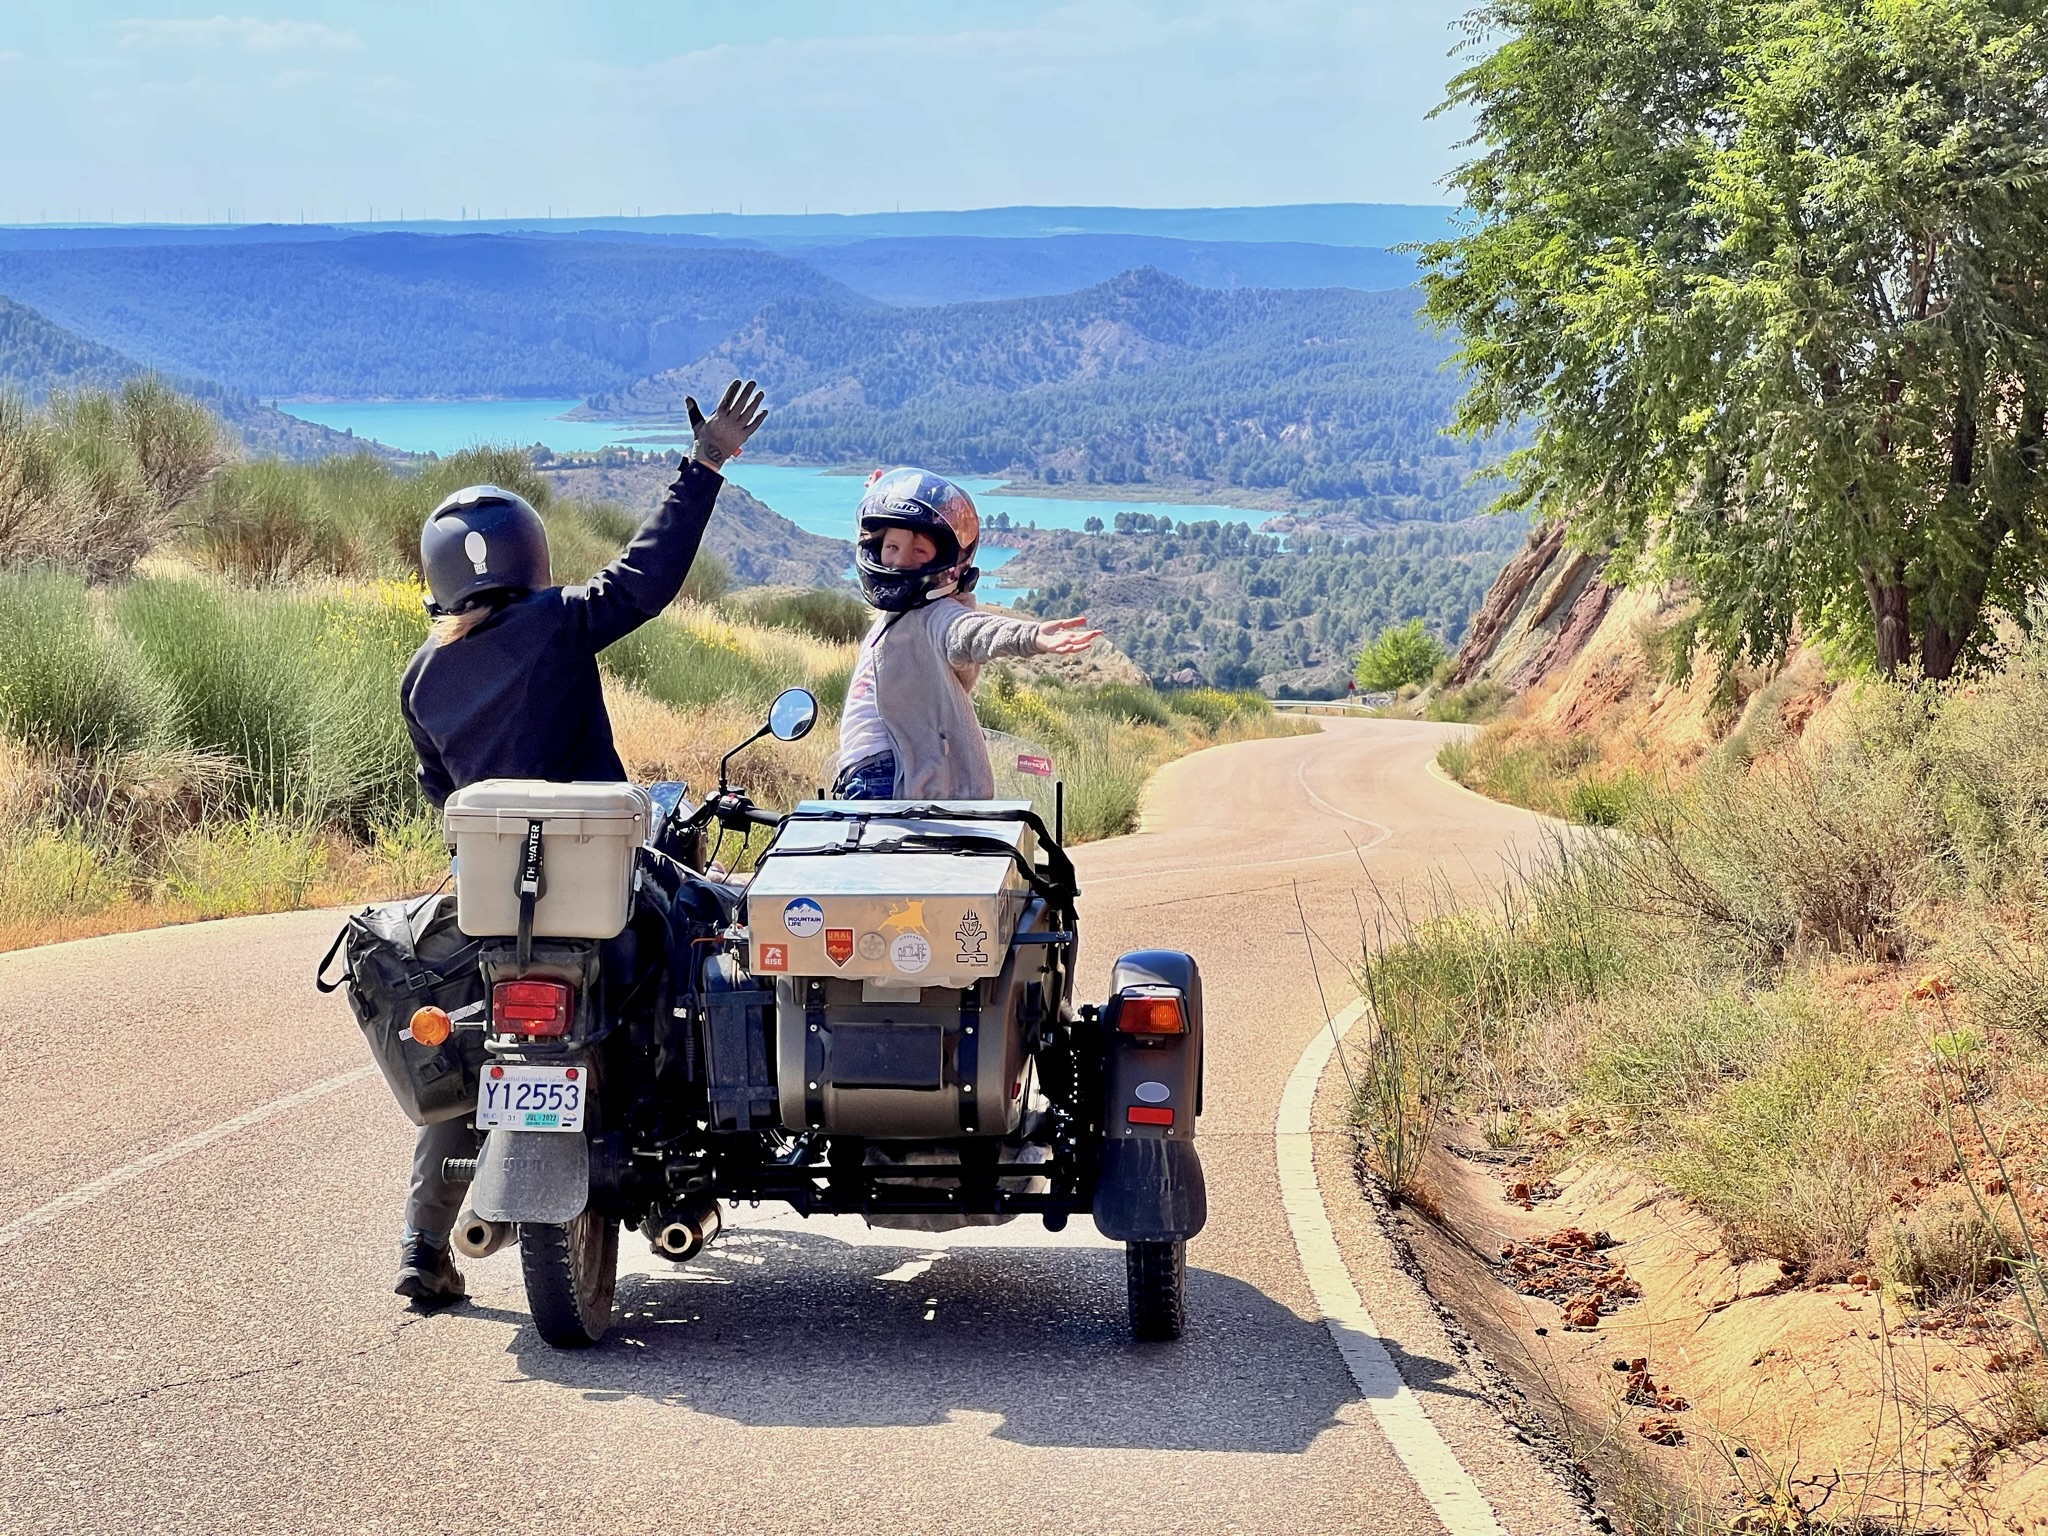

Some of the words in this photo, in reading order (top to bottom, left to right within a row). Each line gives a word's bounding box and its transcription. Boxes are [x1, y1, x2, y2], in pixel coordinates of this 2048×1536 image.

[888, 502, 918, 512] HJC
[527, 825, 540, 862] WATER
[828, 931, 850, 939] URAL
[764, 958, 783, 966] RISE
[486, 1083, 579, 1110] Y12553
[526, 1113, 537, 1121] JUL
